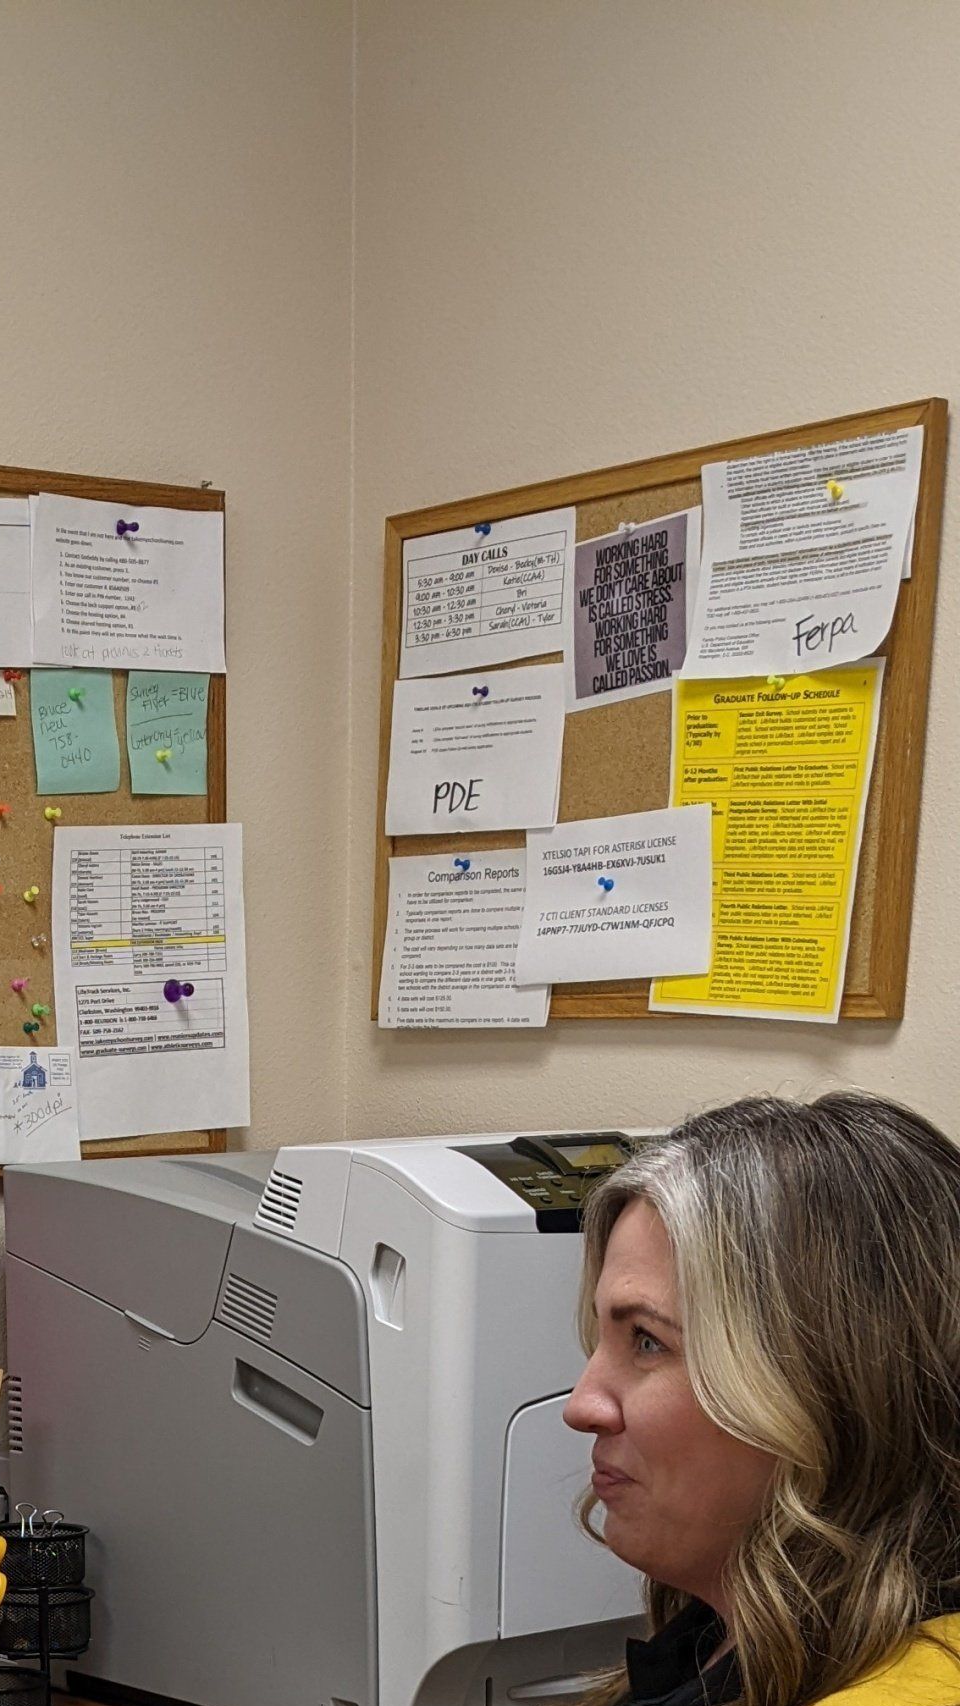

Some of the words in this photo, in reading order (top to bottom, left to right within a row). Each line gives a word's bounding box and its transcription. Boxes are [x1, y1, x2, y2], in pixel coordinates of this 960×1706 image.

[462, 553, 478, 566] DAY
[481, 546, 508, 561] CALLS
[595, 540, 640, 567] WORKING
[641, 530, 668, 550] HARD
[594, 566, 612, 585] FOR
[614, 549, 669, 579] SOMETHING
[579, 589, 594, 607] WE
[596, 579, 624, 602] DON'T
[625, 570, 650, 595] CARE
[651, 562, 684, 587] ABOUT
[589, 605, 597, 623] IS
[599, 595, 634, 620] CALLED
[636, 586, 674, 610] STRESS.
[595, 613, 639, 639] WORKING
[640, 605, 667, 625] HARD
[792, 612, 858, 656] Ferpa
[594, 640, 612, 657] FOR
[614, 623, 669, 654] SOMETHING
[605, 653, 621, 673] WE
[622, 647, 646, 669] LOVE
[647, 644, 657, 663] IS
[592, 668, 628, 694] CALLED
[629, 659, 672, 684] PASSION.
[433, 779, 483, 814] PDE
[542, 849, 572, 861] XTELSIO
[574, 847, 591, 858] TAPI
[593, 845, 610, 855] FOR
[611, 839, 646, 853] ASTERISK
[647, 835, 677, 849] LICENSE
[428, 868, 482, 883] Comparison
[484, 867, 519, 879] Reports
[540, 912, 545, 922] 7
[545, 910, 558, 921] CTI
[559, 908, 586, 919] CLIENT
[587, 903, 630, 917] STANDARD
[632, 901, 669, 914] LICENSES
